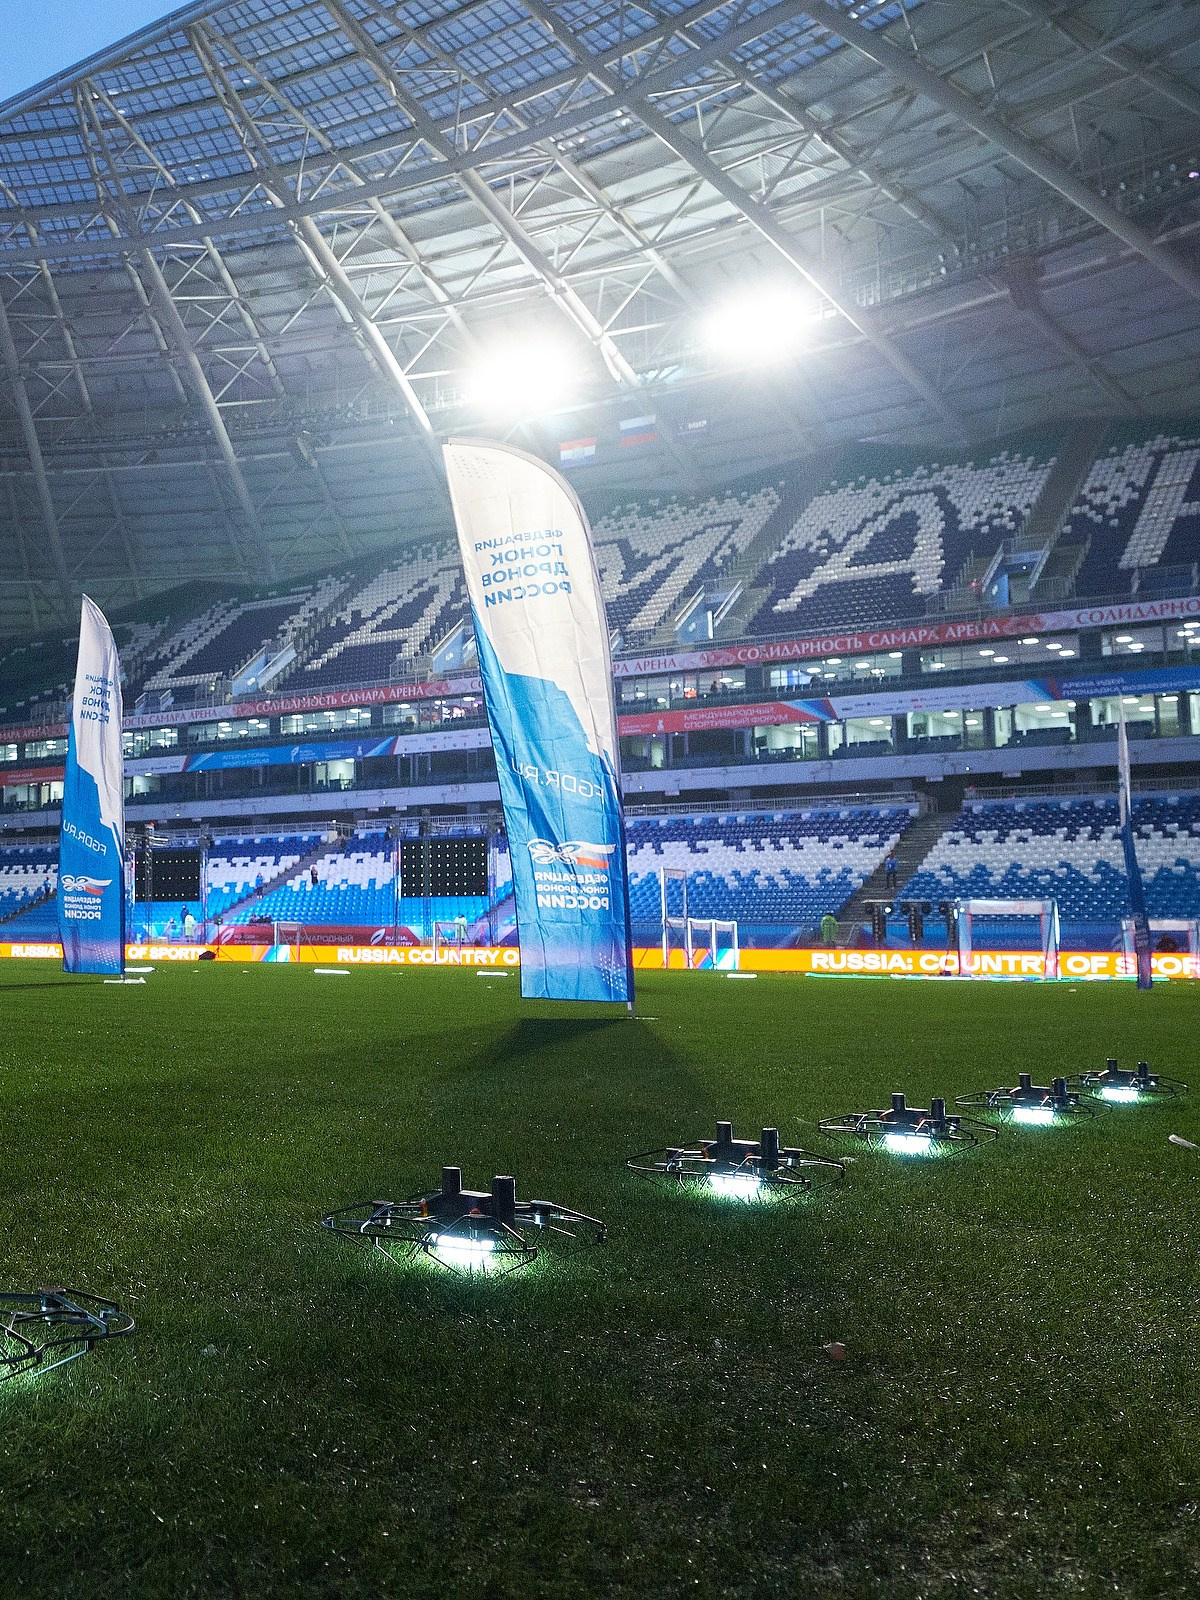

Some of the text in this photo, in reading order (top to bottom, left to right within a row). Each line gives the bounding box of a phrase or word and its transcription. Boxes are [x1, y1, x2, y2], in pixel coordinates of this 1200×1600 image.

[737, 637, 863, 661] СОЛИДАРНОСТЬ
[869, 628, 939, 646] САМАРА
[634, 658, 677, 672] АРЕНА
[256, 685, 424, 712] СОЛИДАРНОСТЬ САМАРА АРЕНА
[150, 713, 187, 725] САМАРА
[189, 709, 217, 721] АРЕНА
[11, 945, 60, 958] RUSSIA:
[128, 946, 148, 959] OF
[337, 948, 405, 962] RUSSIA:
[408, 949, 500, 964] COUNTRY
[811, 953, 913, 970] RUSSIA:
[1067, 955, 1109, 973] OF
